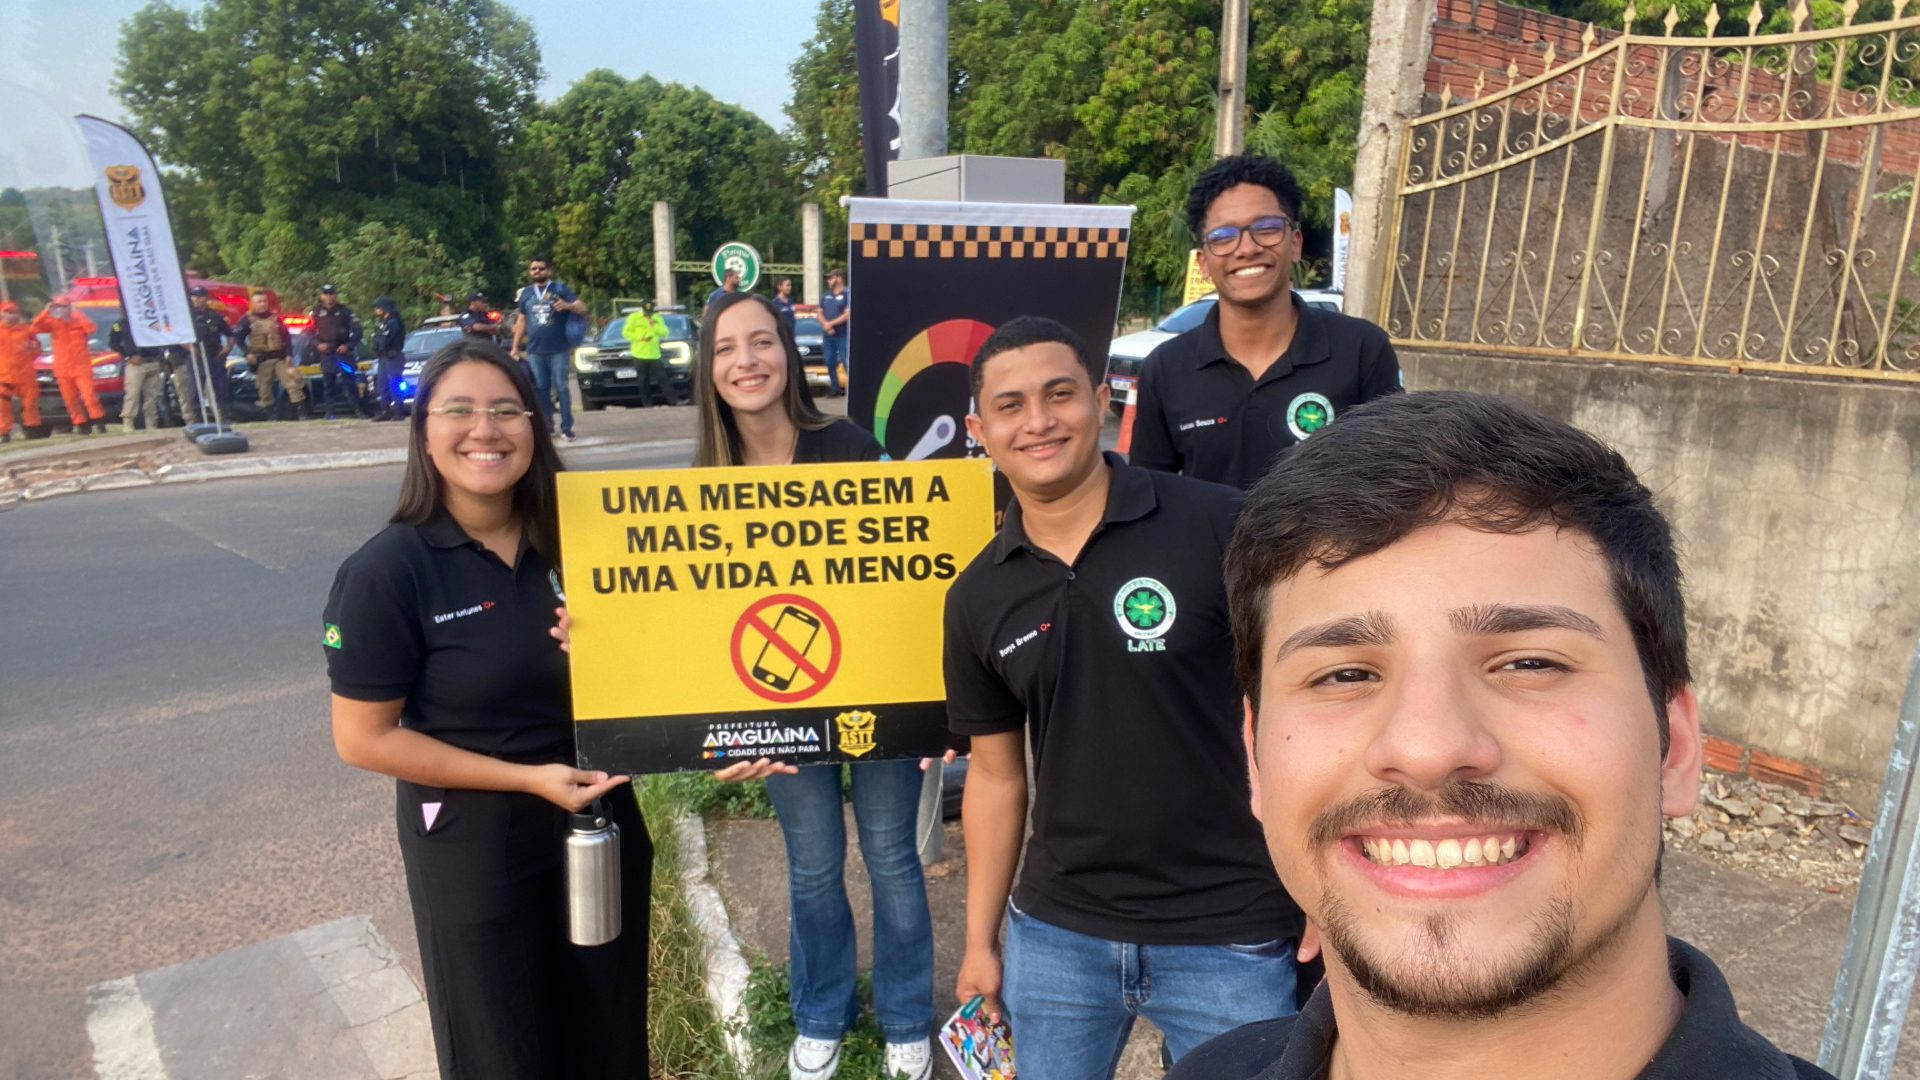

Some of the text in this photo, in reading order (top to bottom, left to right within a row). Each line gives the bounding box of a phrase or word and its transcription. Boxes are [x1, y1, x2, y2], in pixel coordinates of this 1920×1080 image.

[1195, 418, 1216, 428] Souza
[602, 475, 950, 514] UMA MENSAGEM A
[627, 515, 929, 556] MAIS, PODE SER
[593, 553, 962, 594] UMA VIDA A MENOS
[1127, 638, 1166, 653] LATE
[708, 721, 778, 731] PREFEITURA
[840, 730, 874, 745] ASTT
[727, 744, 820, 758] CIDADE QUE NÃO PARA
